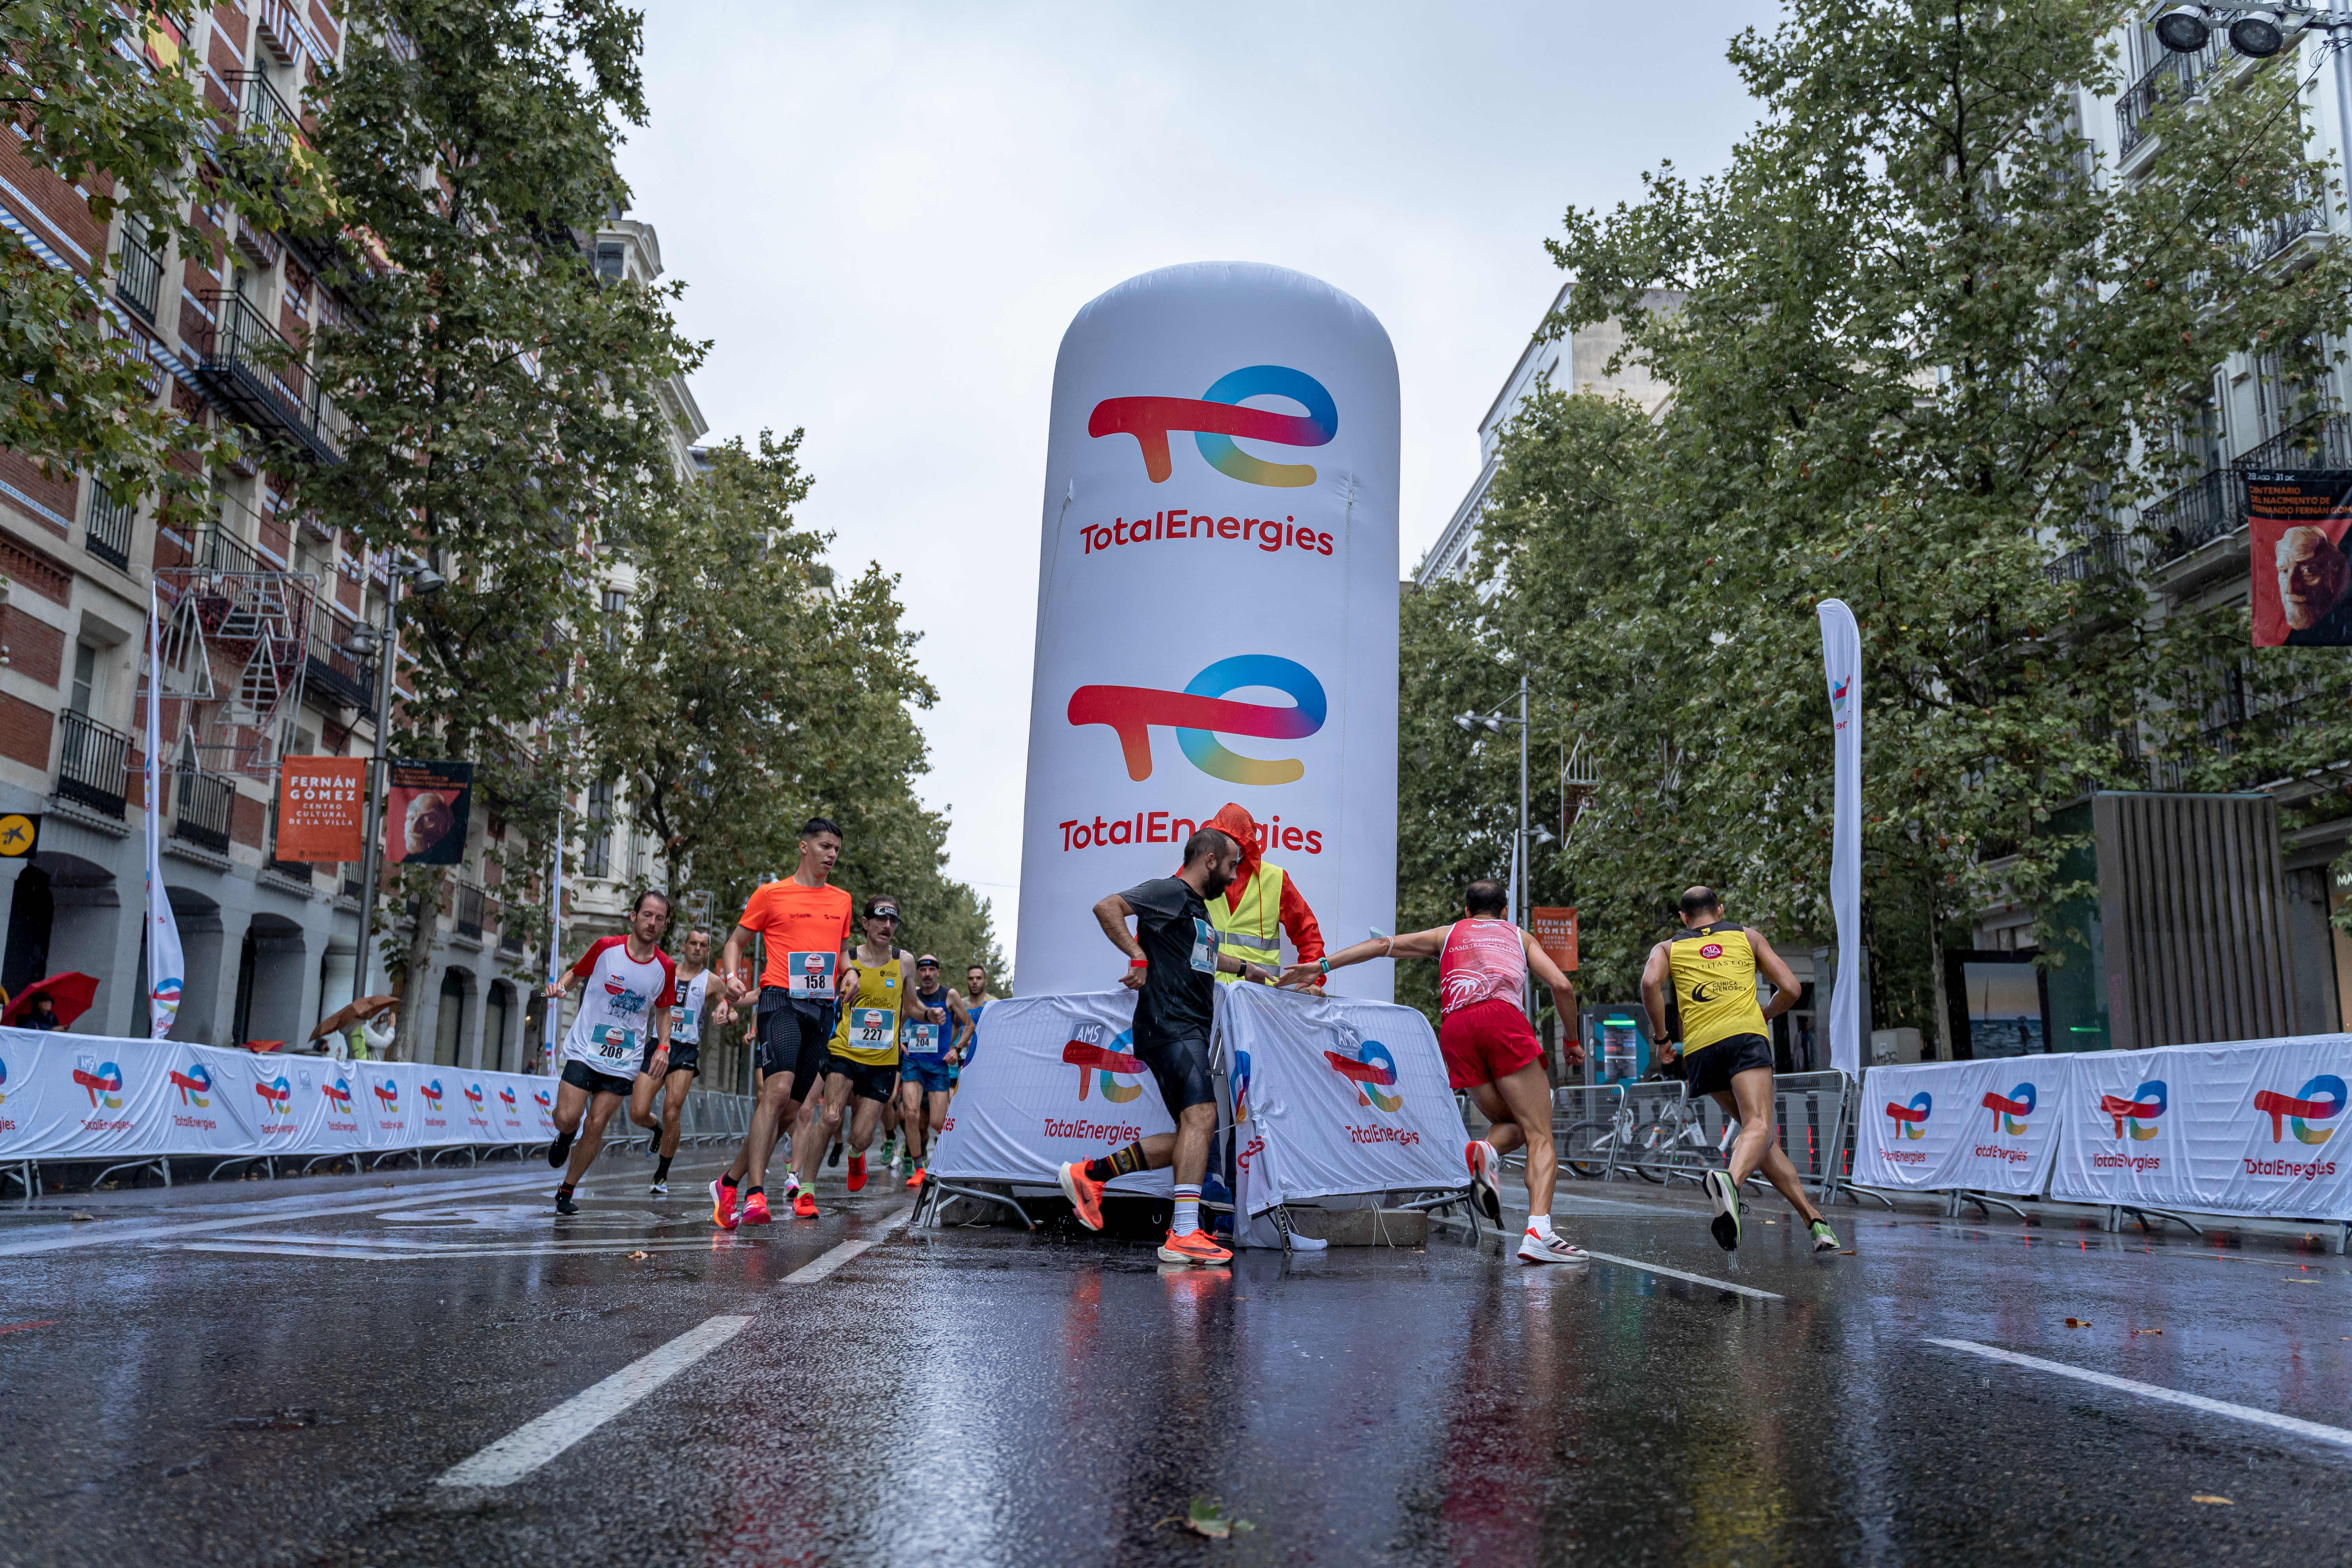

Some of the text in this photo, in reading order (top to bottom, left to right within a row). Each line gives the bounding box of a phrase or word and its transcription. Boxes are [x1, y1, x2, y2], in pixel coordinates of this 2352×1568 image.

[1080, 509, 1333, 556] TotalEnergies
[291, 775, 356, 788] FERNÁN
[290, 787, 355, 801] GÓMEZ
[1060, 811, 1322, 855] TotalEngies
[1448, 945, 1468, 953] OASIS
[804, 975, 825, 989] 158
[671, 1022, 683, 1033] 14
[862, 1028, 882, 1041] 227
[1076, 1025, 1101, 1042] AMS
[916, 1038, 929, 1047] 204
[599, 1044, 623, 1059] 208
[1044, 1118, 1142, 1146] TotalEnergies
